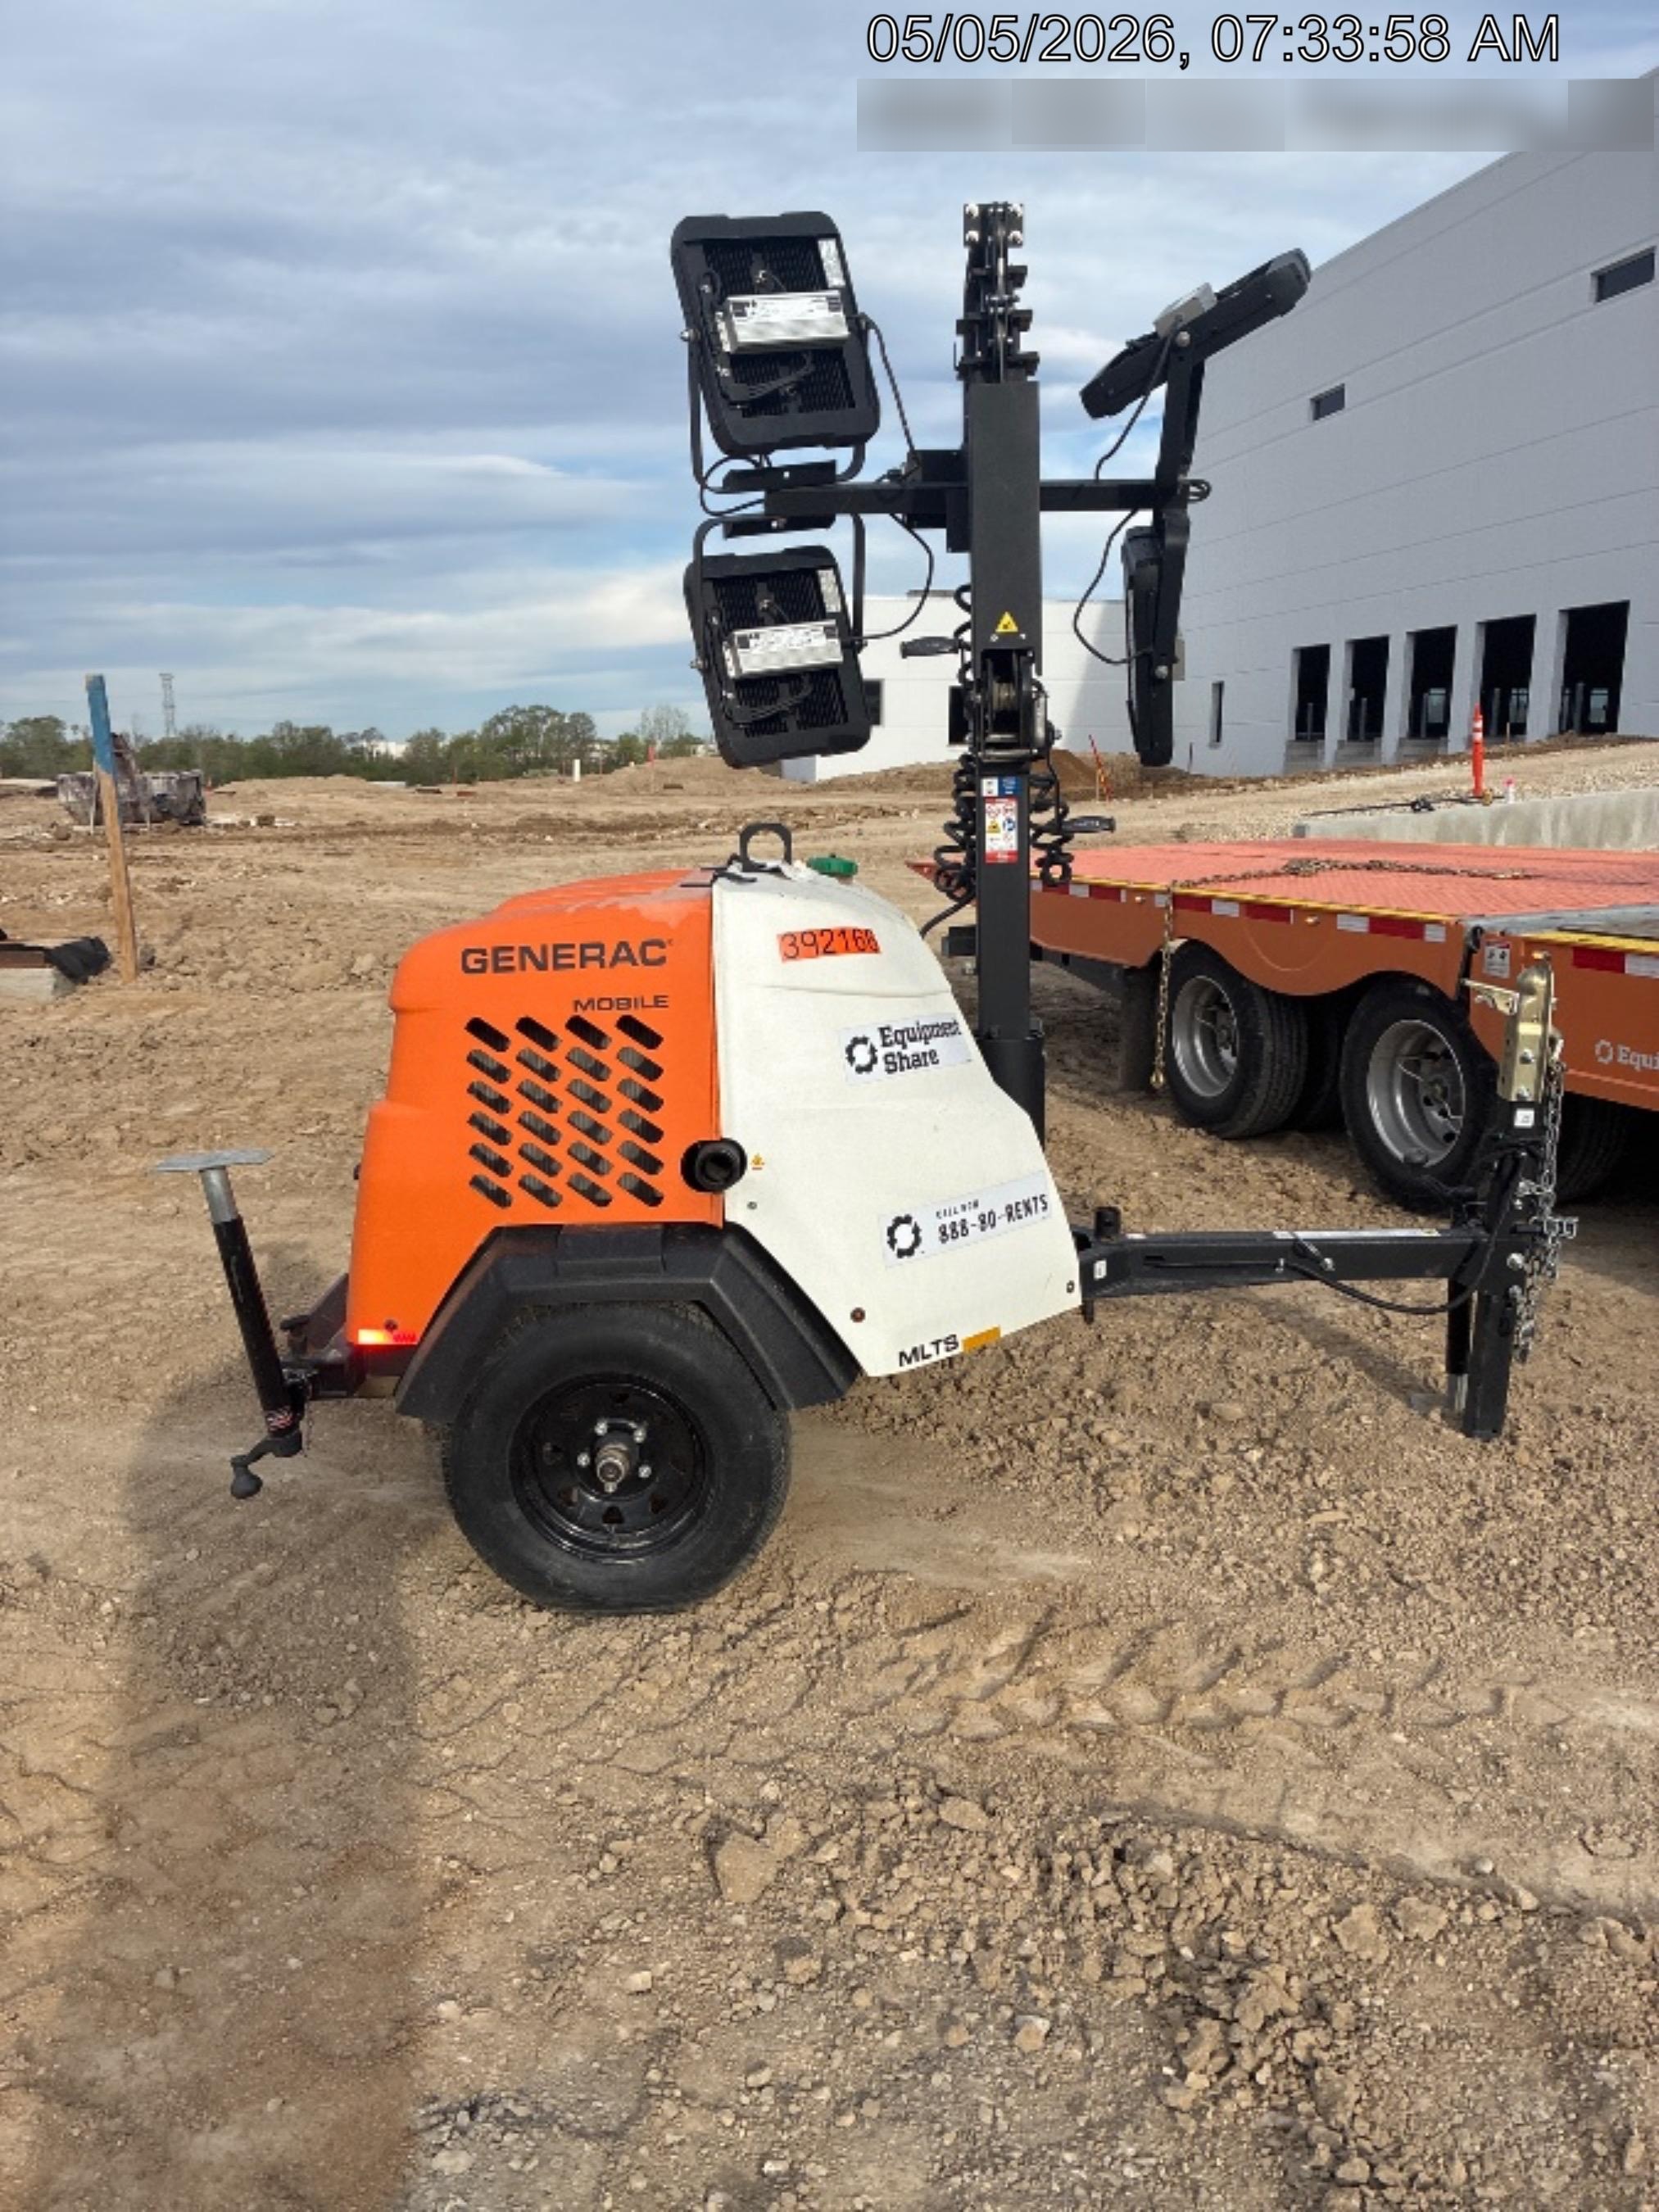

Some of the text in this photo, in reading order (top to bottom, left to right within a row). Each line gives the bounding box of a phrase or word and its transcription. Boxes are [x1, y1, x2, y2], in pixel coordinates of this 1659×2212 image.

[460, 938, 668, 974] GENERAC
[573, 995, 669, 1013] MOBILE
[882, 1049, 940, 1074] Share
[898, 1334, 959, 1367] MLTS
